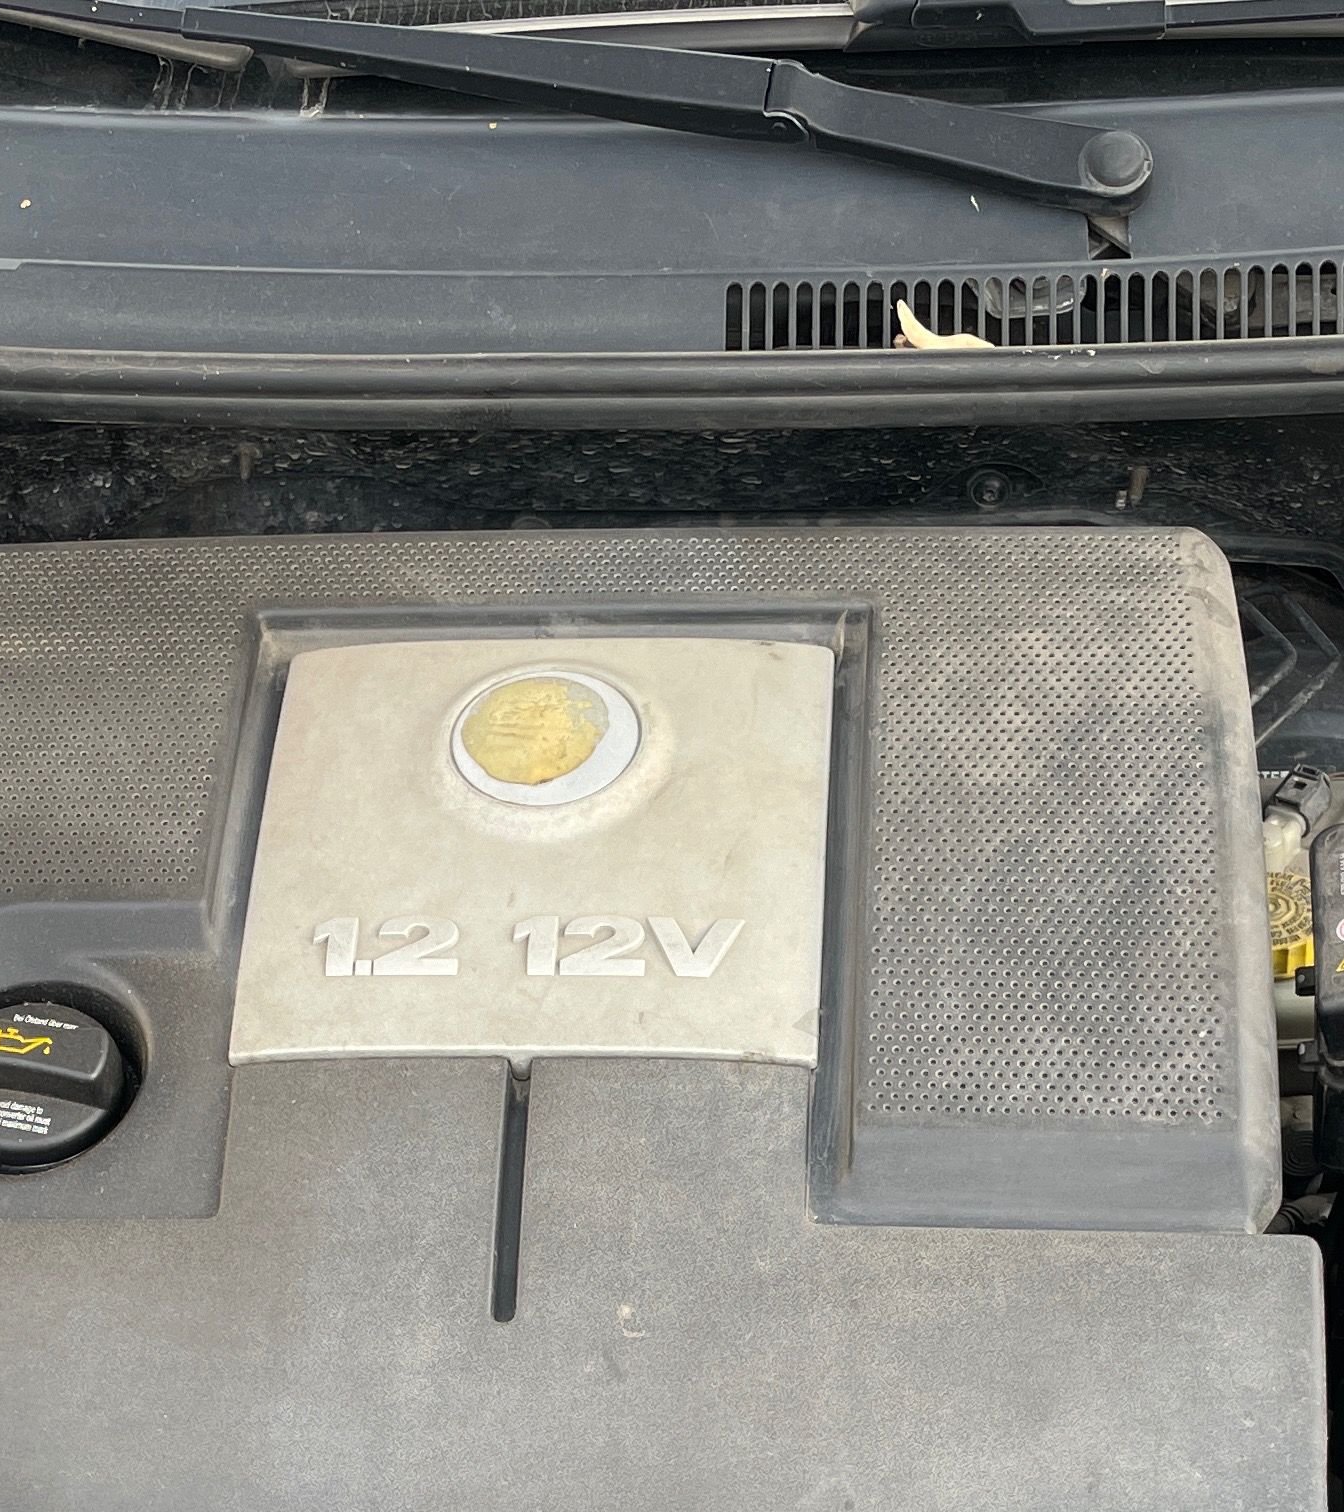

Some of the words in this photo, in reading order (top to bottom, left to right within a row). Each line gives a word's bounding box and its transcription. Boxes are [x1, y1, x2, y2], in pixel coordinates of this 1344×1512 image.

[312, 915, 460, 976] 1.2
[511, 914, 746, 977] 12V
[10, 1101, 36, 1115] damage
[36, 1106, 44, 1115] to
